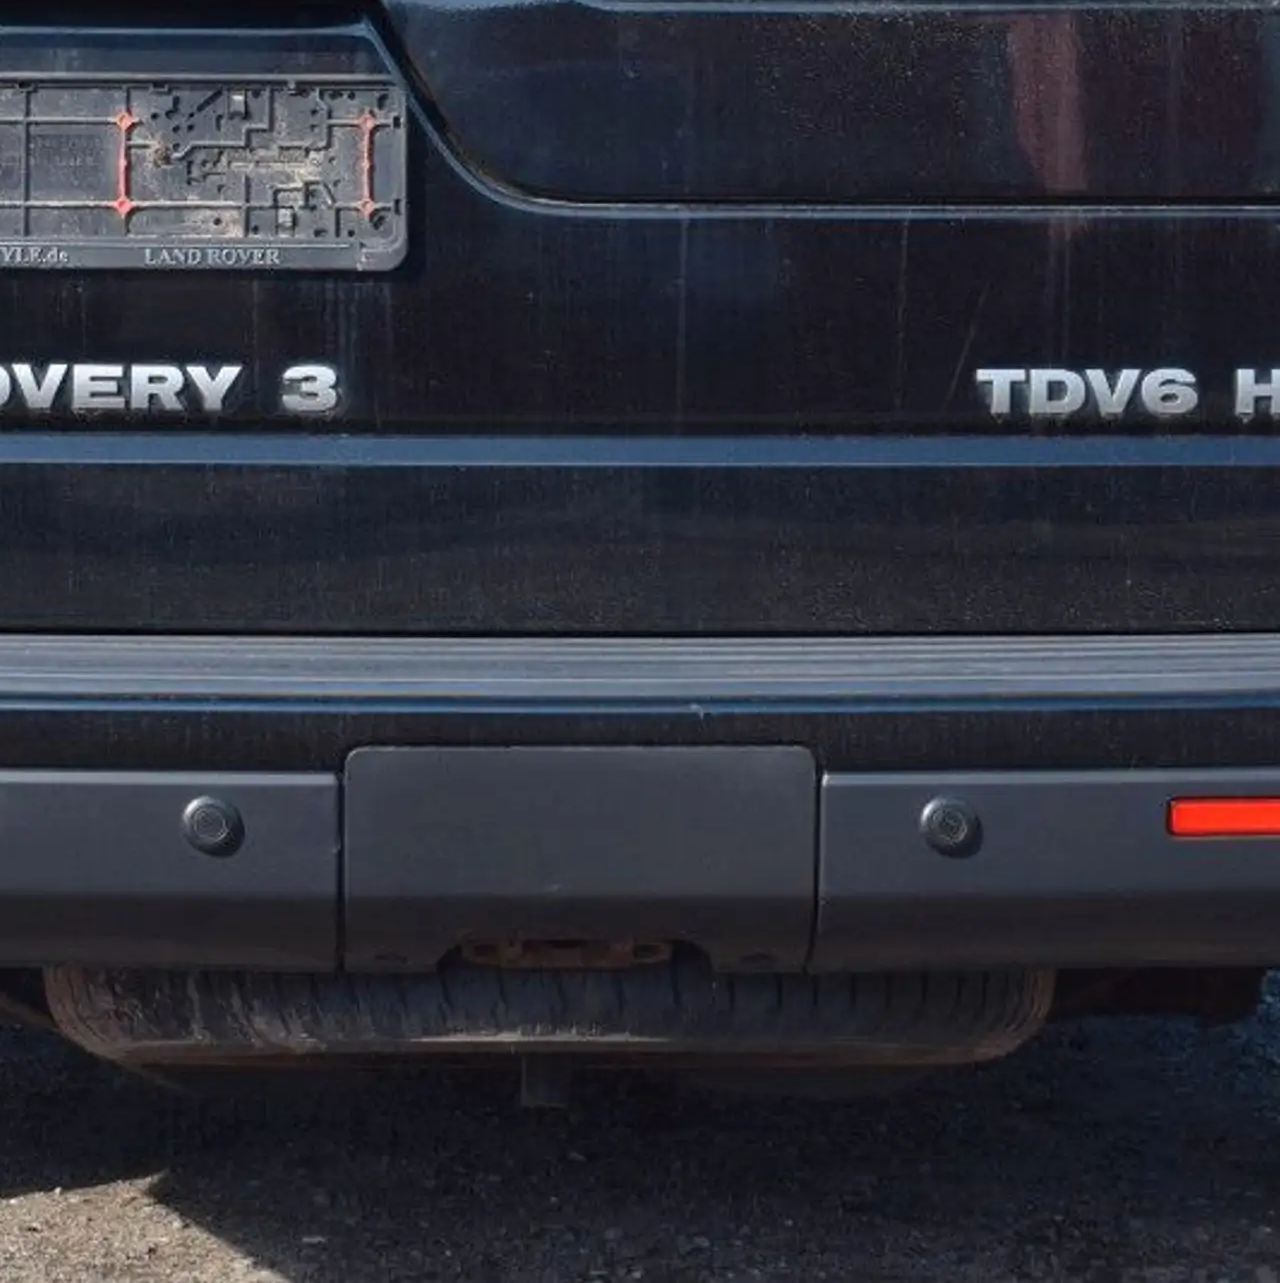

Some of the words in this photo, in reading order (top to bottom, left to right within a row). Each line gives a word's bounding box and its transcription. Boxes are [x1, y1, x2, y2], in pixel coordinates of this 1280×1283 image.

[144, 248, 202, 264] LAND
[207, 248, 281, 265] ROVER
[281, 364, 341, 413] 3
[976, 367, 1200, 416] TDV6
